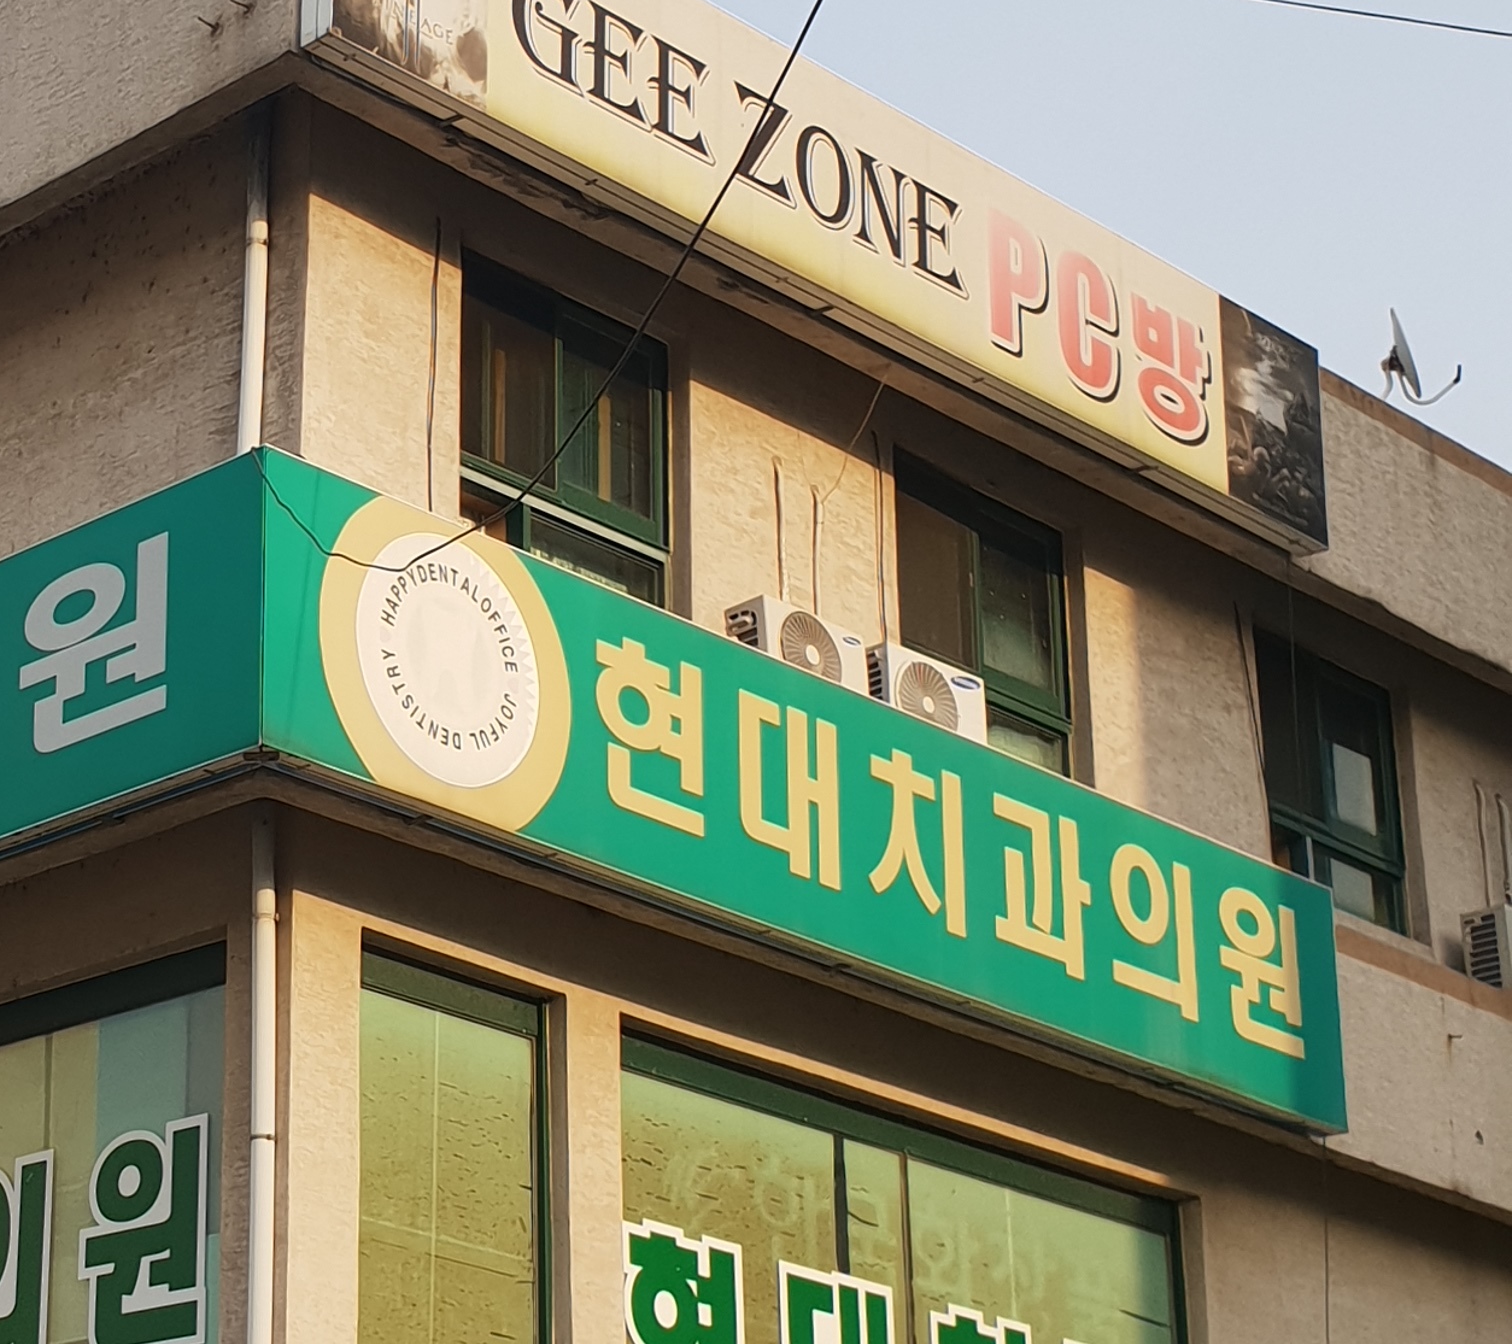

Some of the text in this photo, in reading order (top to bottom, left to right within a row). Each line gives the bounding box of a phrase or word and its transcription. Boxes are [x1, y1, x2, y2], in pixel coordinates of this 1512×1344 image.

[734, 81, 969, 299] ZONE
[987, 207, 1211, 445] PC방
[380, 648, 518, 751] JOYFUL DENTISTRY
[594, 635, 1306, 1060] 현대치과의원
